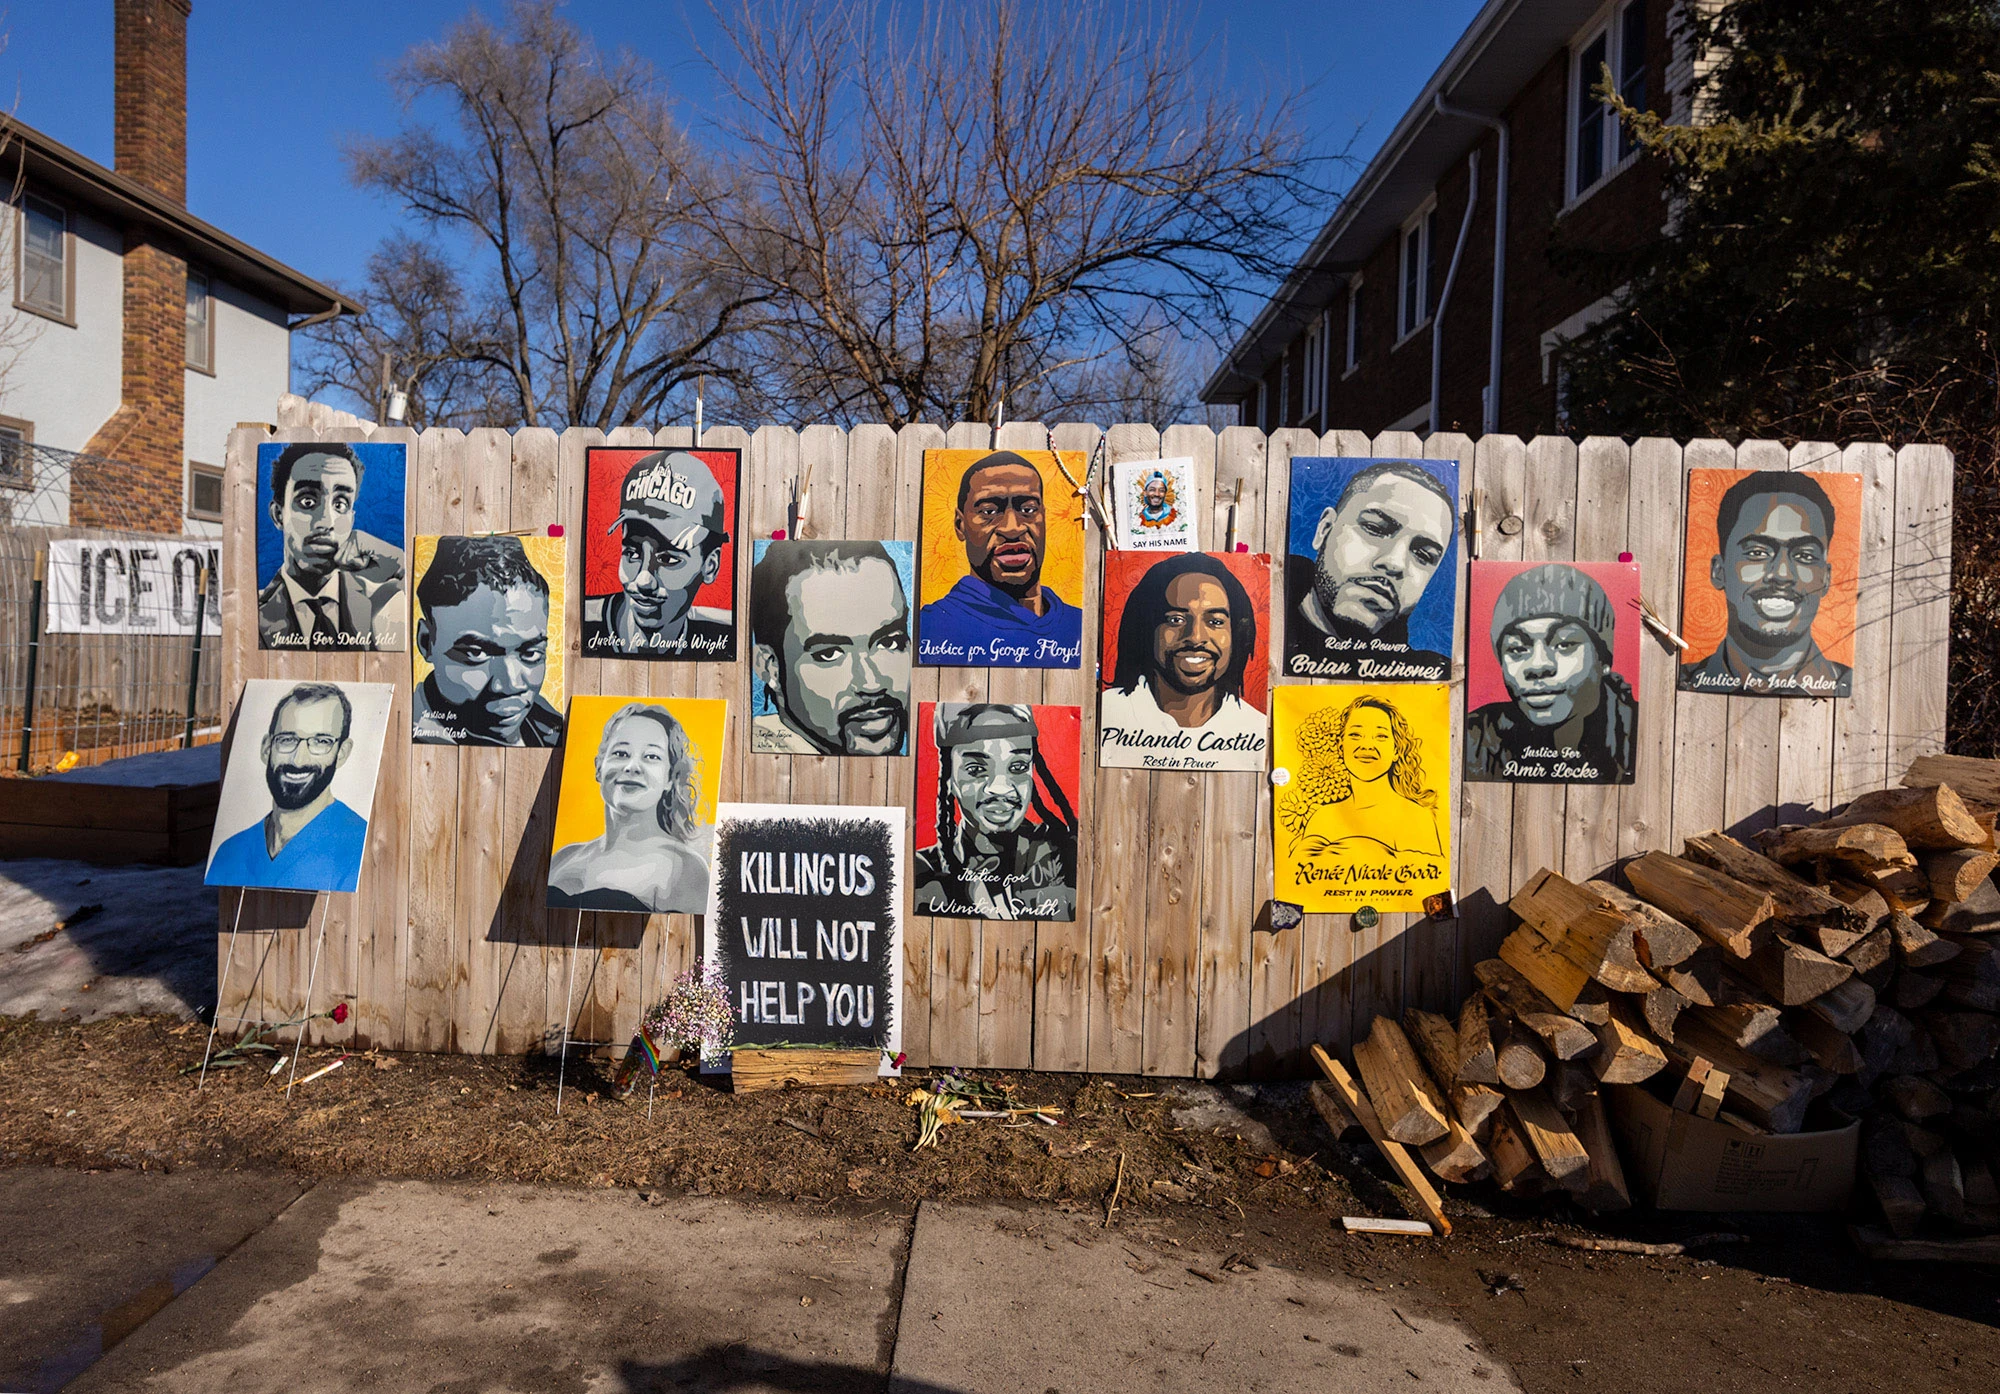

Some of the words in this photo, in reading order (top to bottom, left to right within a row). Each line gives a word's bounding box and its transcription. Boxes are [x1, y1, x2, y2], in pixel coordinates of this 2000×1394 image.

[626, 464, 697, 510] CHICAGO
[1132, 540, 1147, 549] SAY
[1148, 539, 1162, 548] HIS
[1163, 537, 1188, 547] NAME
[80, 547, 158, 627] ICE
[271, 631, 309, 647] Justice
[312, 631, 335, 646] For
[337, 631, 371, 646] Dolal
[588, 630, 626, 649] Justice
[628, 633, 647, 652] for
[650, 633, 688, 649] Daunte
[691, 634, 729, 654] Wright
[1324, 636, 1352, 651] Rest
[1353, 639, 1367, 650] in
[1370, 638, 1410, 653] Power
[919, 639, 964, 656] Justice
[967, 645, 986, 661] for
[990, 637, 1030, 663] George
[1034, 638, 1081, 663] Floyd
[1290, 654, 1352, 675] Brian
[1357, 658, 1444, 680] Quiñones
[1692, 671, 1742, 689] Justice
[1743, 673, 1763, 691] for
[1767, 674, 1798, 689] Isak
[1800, 675, 1838, 690] Aden
[420, 709, 446, 720] Justice
[446, 710, 458, 721] for
[412, 726, 440, 738] Jamar
[442, 727, 468, 739] Clark
[1101, 727, 1193, 749] Philando
[1197, 731, 1266, 752] Castile
[1142, 755, 1168, 767] Rest
[1168, 757, 1181, 768] in
[1183, 757, 1219, 769] Power
[1520, 745, 1559, 759] Justice
[1560, 746, 1582, 759] For
[1502, 760, 1548, 777] Amir
[1550, 761, 1600, 779] Locke
[740, 851, 836, 896] KILLING
[838, 852, 876, 897] US
[957, 867, 1001, 882] Justice
[1002, 873, 1030, 888] for
[1295, 861, 1345, 886] Renée
[1344, 863, 1393, 885] Nicole
[1394, 863, 1440, 884] Good
[1323, 889, 1353, 897] REST
[1355, 889, 1366, 897] IN
[1369, 888, 1414, 897] POWER
[929, 895, 1000, 915] Winston
[1009, 897, 1061, 917] Smith
[740, 916, 808, 960] WILL
[815, 919, 876, 963] NOT
[740, 980, 816, 1025] HELP
[818, 982, 875, 1029] YOU
